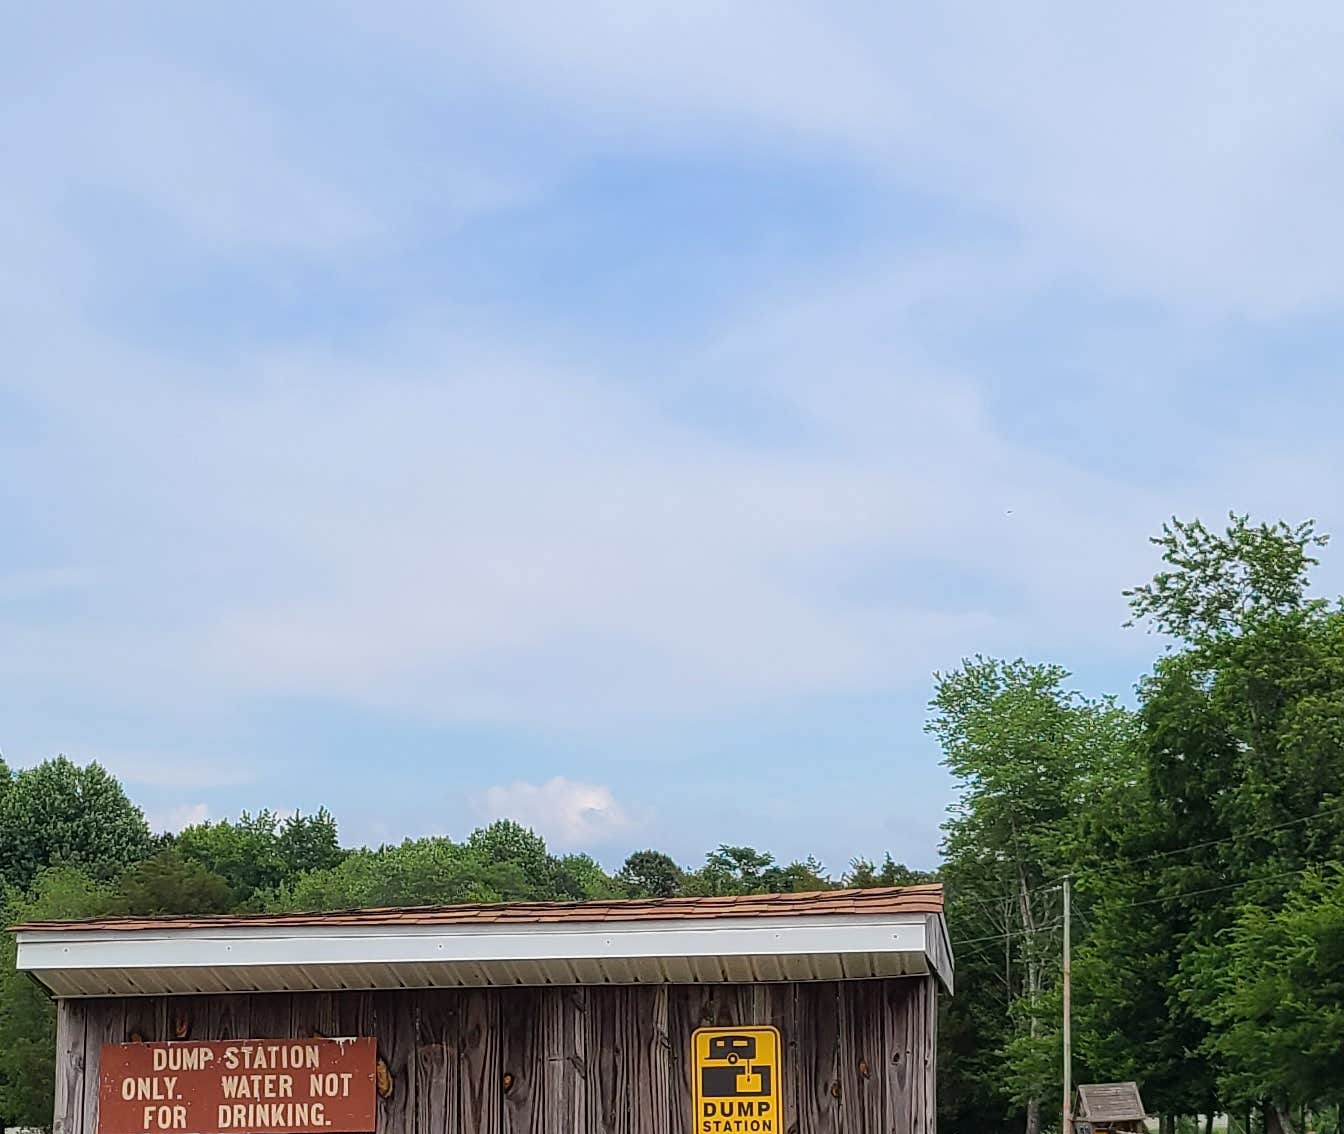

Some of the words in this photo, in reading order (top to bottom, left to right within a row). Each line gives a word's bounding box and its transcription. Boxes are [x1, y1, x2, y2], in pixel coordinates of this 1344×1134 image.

[153, 1046, 214, 1071] DUMP
[224, 1045, 320, 1070] STATION
[122, 1077, 183, 1101] ONLY.
[222, 1075, 293, 1099] WATER
[309, 1073, 353, 1097] NOT
[143, 1105, 187, 1129] FOR
[218, 1103, 332, 1128] DRINKING.
[703, 1101, 771, 1118] DUMP
[703, 1120, 772, 1133] STATION
